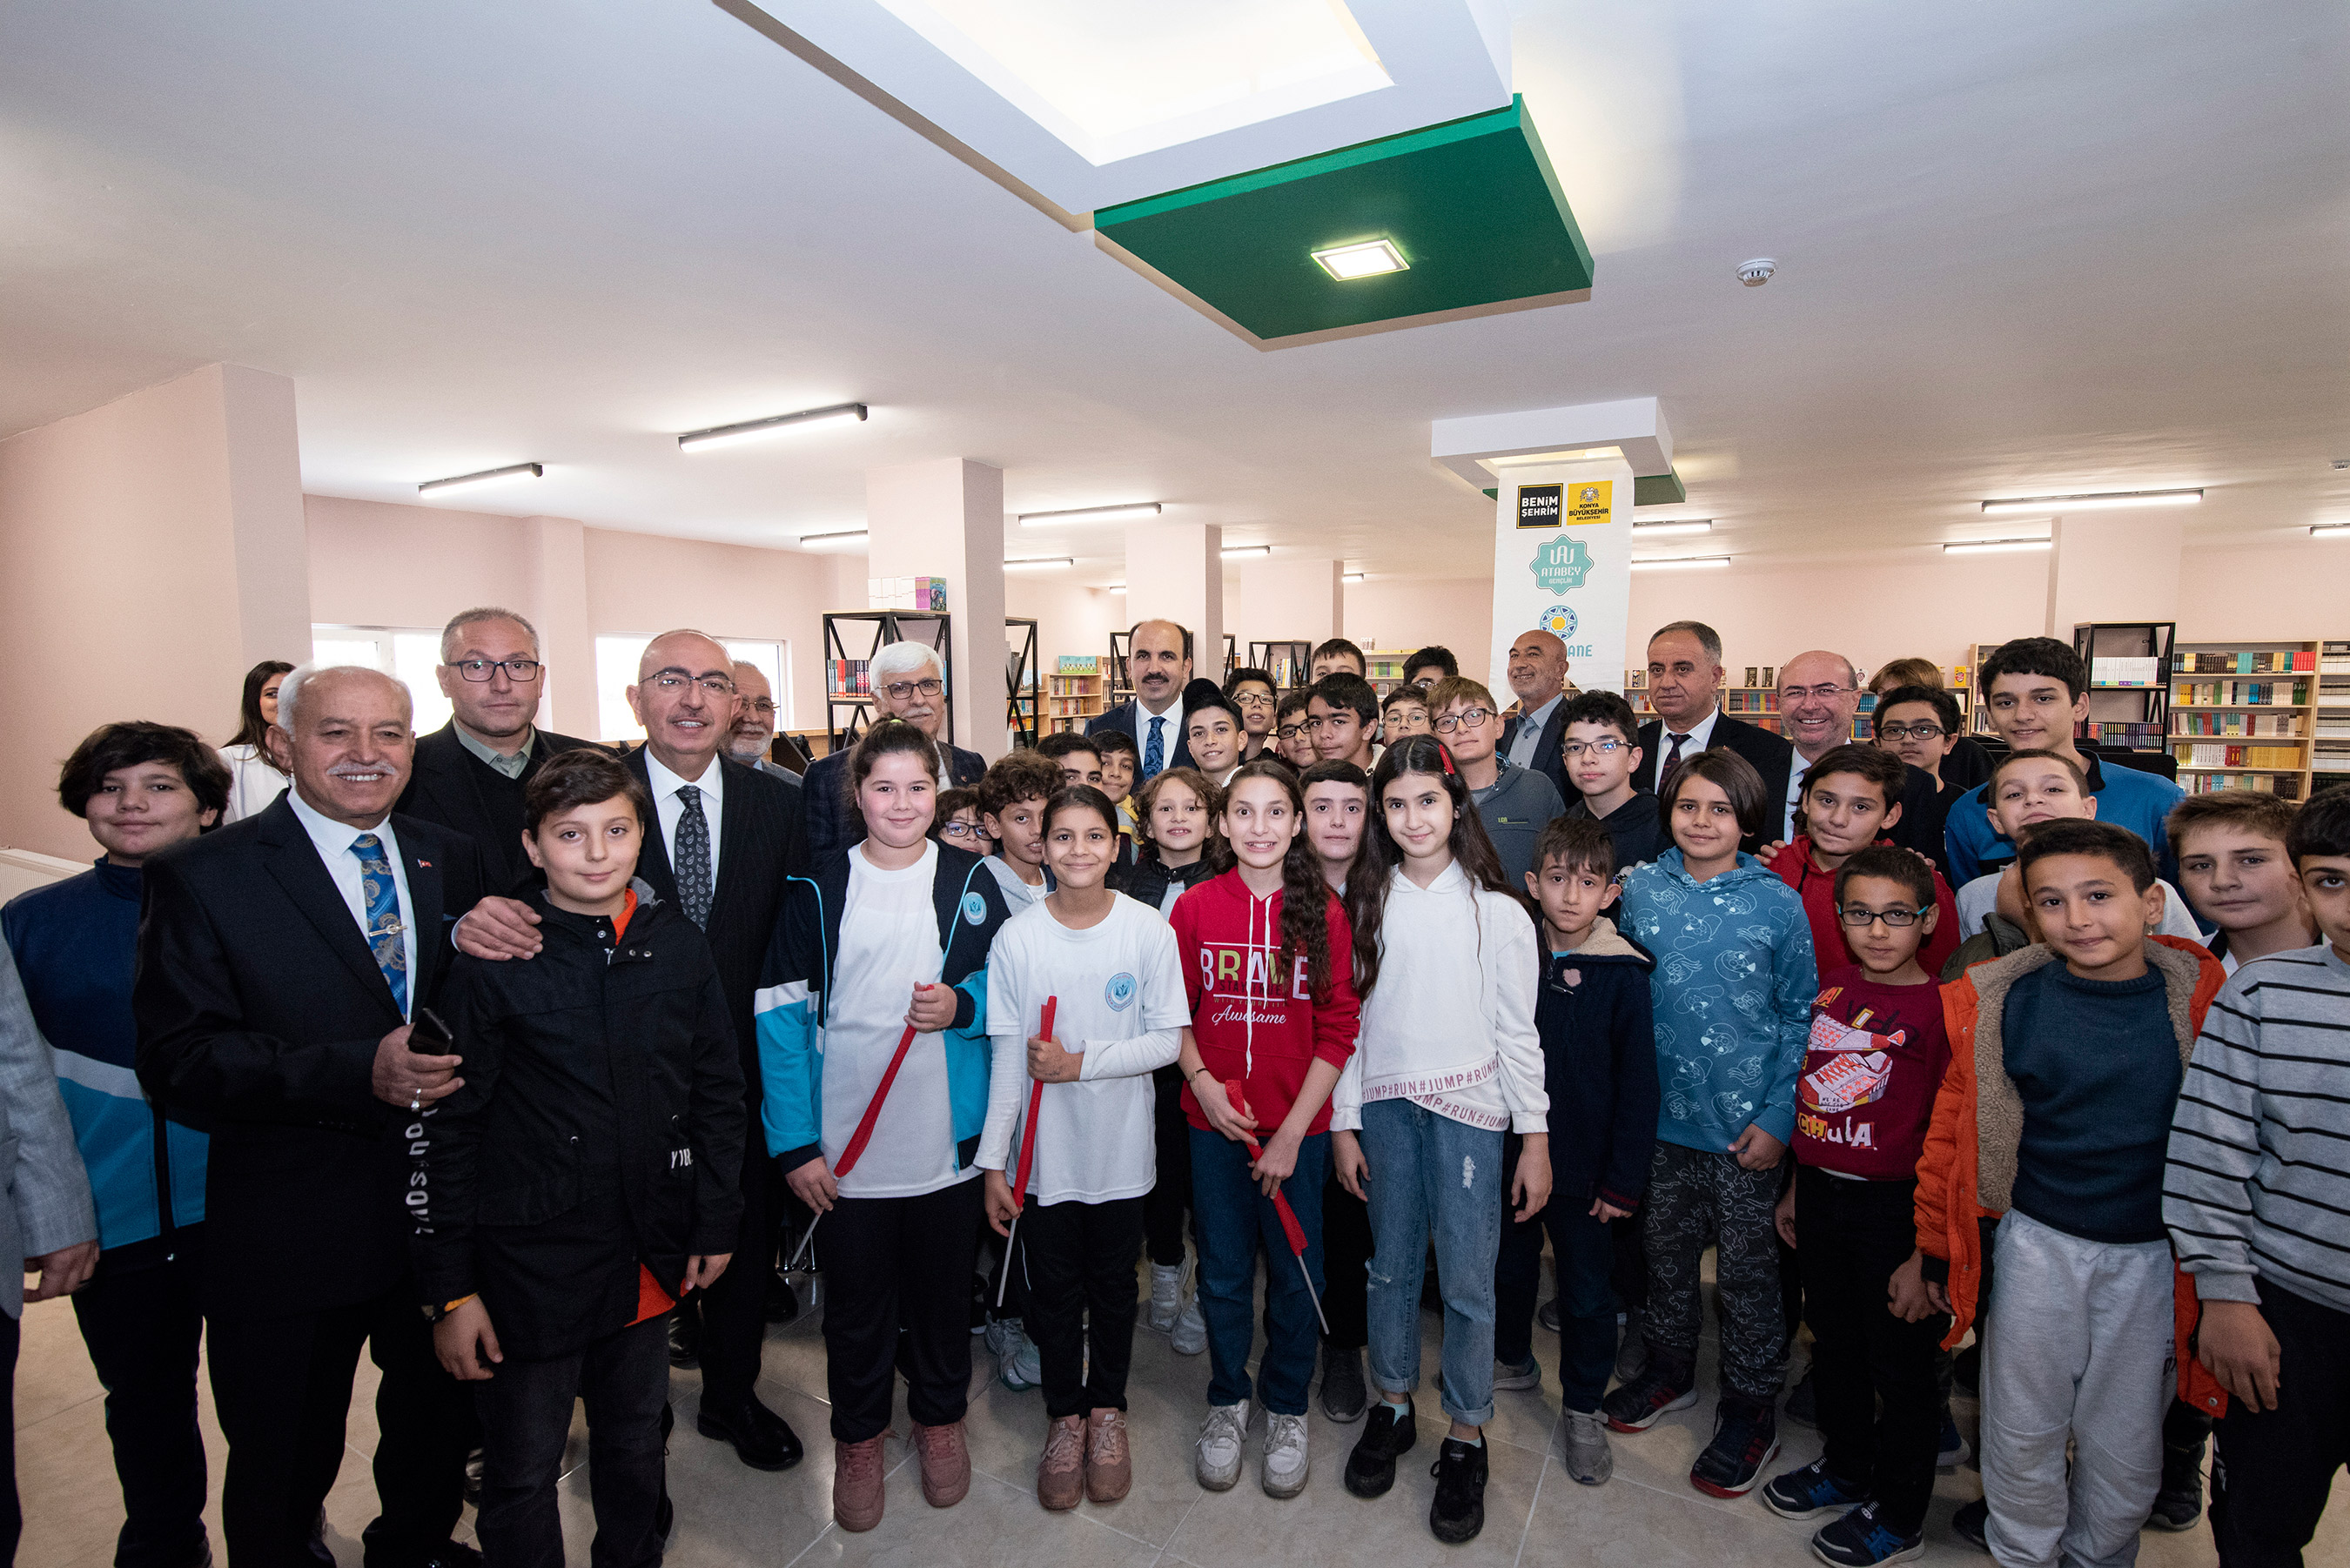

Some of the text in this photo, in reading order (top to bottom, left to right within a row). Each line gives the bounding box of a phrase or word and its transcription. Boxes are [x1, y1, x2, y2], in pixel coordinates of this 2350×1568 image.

[1521, 505, 1558, 518] ŞEHRİM
[1568, 507, 1609, 517] BÜYÜKŞEHİR
[1541, 566, 1581, 577] ATABEY
[1199, 947, 1312, 1000] BRAVE
[1220, 980, 1283, 996] STAY TRUE
